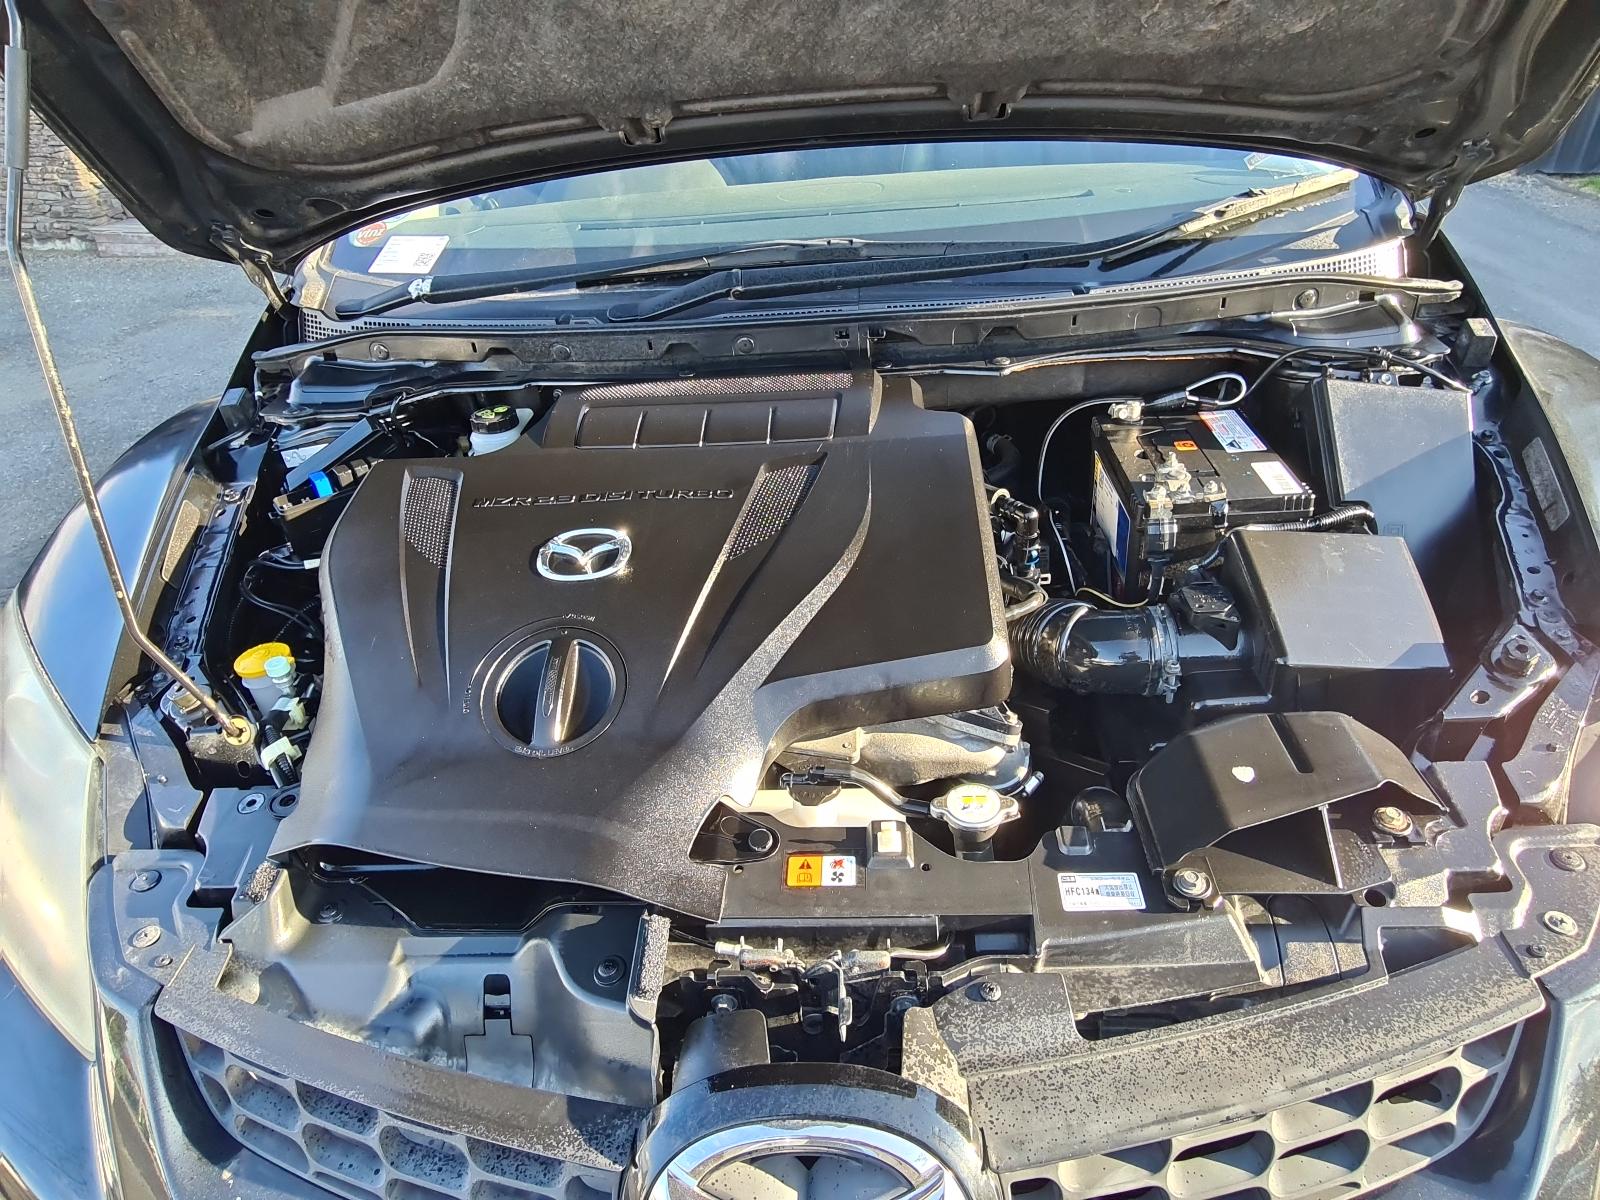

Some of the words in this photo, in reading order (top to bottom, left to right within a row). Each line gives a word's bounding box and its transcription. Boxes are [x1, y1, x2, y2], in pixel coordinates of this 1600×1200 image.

[472, 496, 532, 508] MZR
[578, 490, 634, 503] DISI
[636, 488, 735, 501] TURBO
